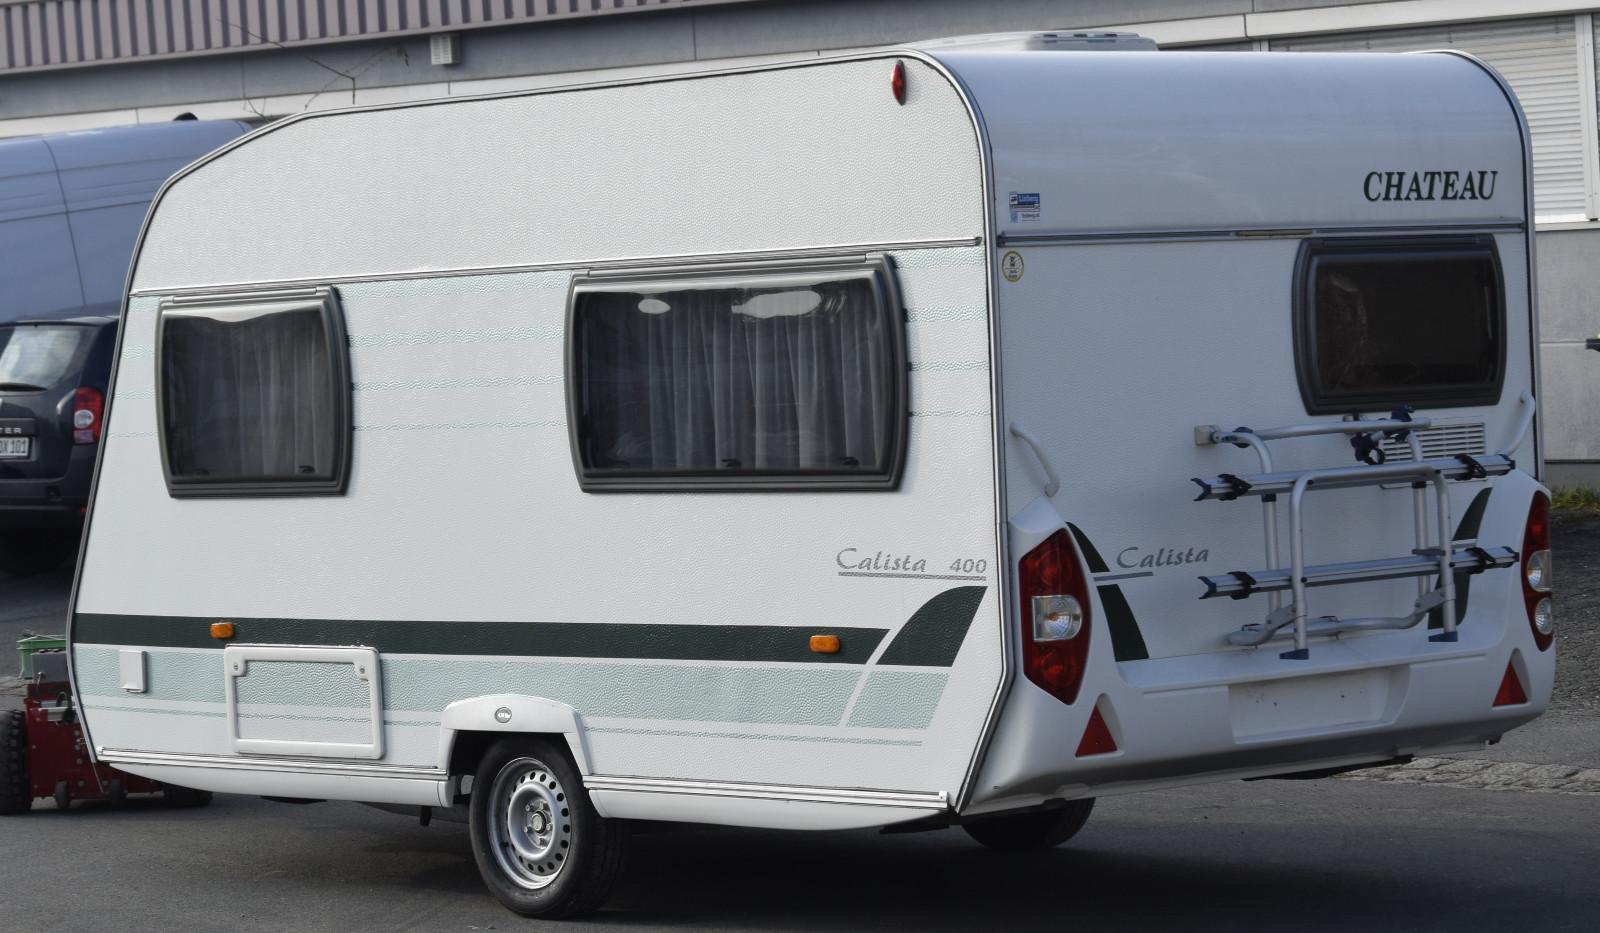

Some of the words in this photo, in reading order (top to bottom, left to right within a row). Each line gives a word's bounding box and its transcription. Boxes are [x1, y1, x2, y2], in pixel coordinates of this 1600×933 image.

[1363, 171, 1499, 202] CHATEAU
[10, 440, 26, 454] 101
[836, 547, 927, 573] Calista
[949, 558, 988, 574] 400
[1116, 546, 1209, 569] Calista
